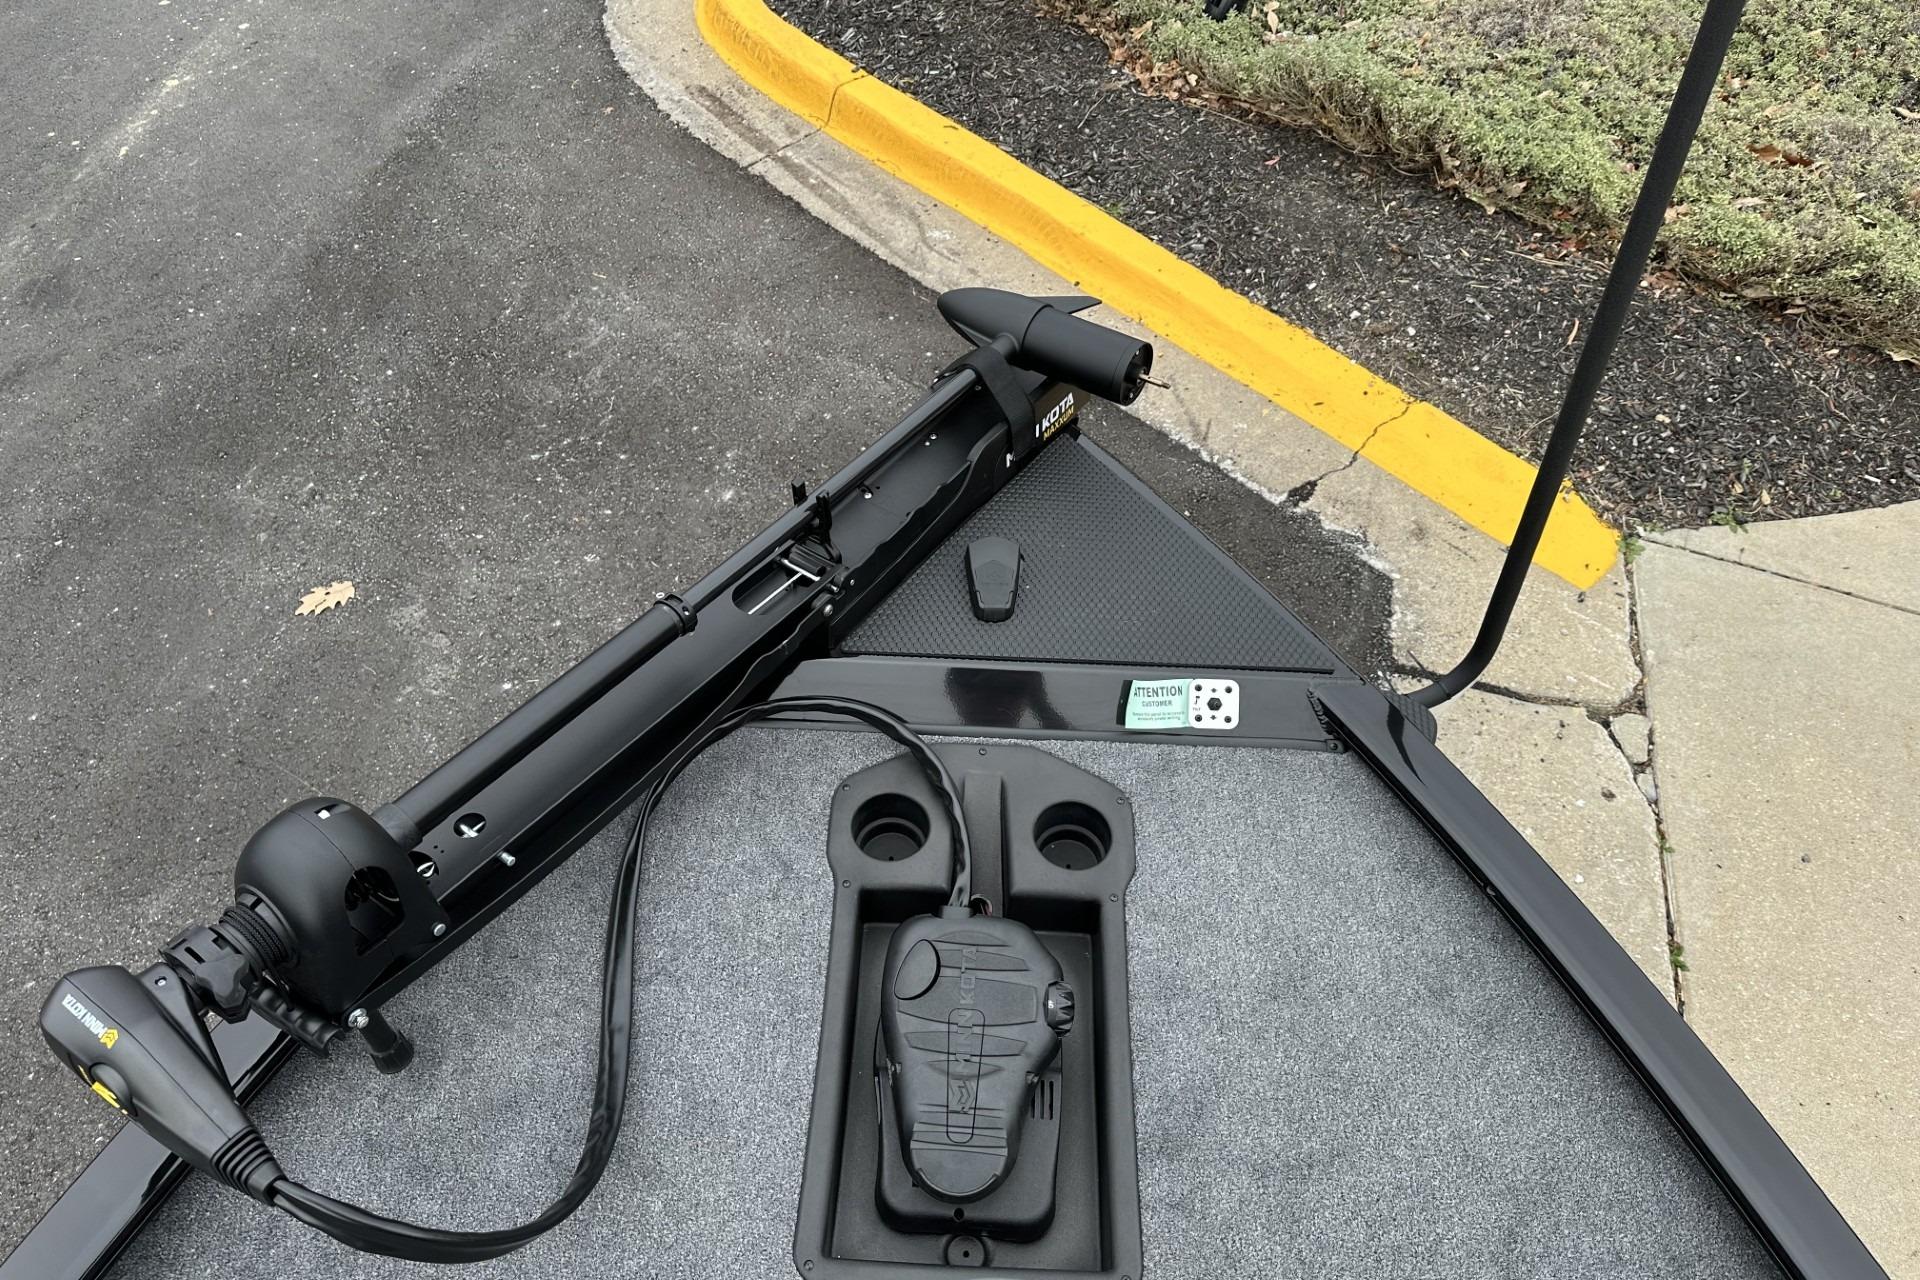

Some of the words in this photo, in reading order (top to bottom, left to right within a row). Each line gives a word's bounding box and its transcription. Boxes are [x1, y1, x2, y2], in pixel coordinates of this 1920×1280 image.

[1042, 392, 1074, 431] KOTA
[1043, 405, 1074, 441] MAXXUM
[1133, 686, 1183, 698] ATTENTION
[1142, 699, 1173, 707] CUSTOMER
[959, 946, 977, 1005] KOTA
[61, 993, 88, 1020] KOTA
[81, 1012, 108, 1039] MINN
[956, 1009, 974, 1074] MINN
